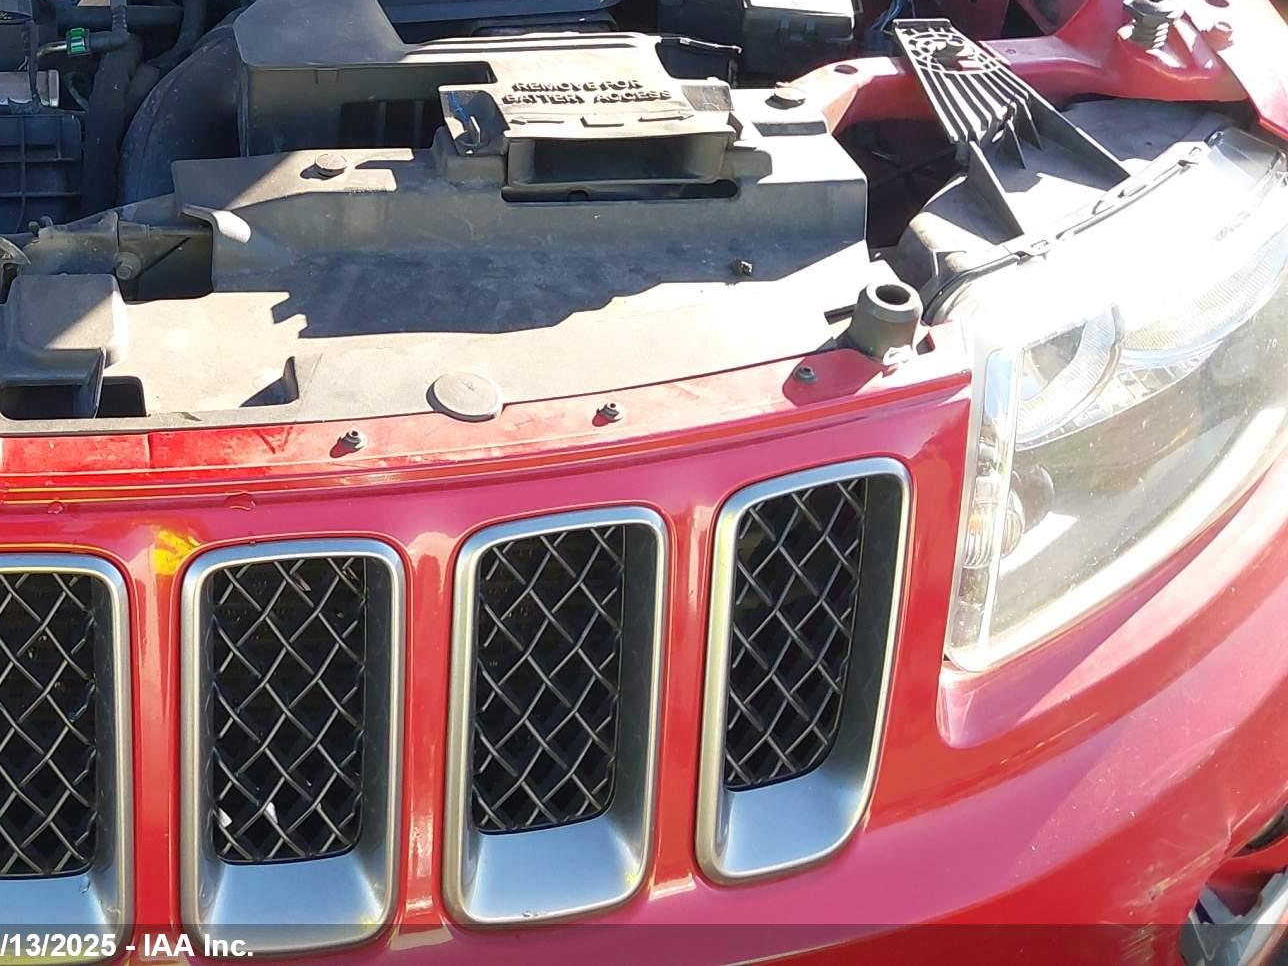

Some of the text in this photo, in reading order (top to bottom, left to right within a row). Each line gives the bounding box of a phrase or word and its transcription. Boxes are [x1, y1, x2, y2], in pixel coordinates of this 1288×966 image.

[512, 79, 643, 92] REMOVE FOR
[593, 90, 672, 104] ACCESS
